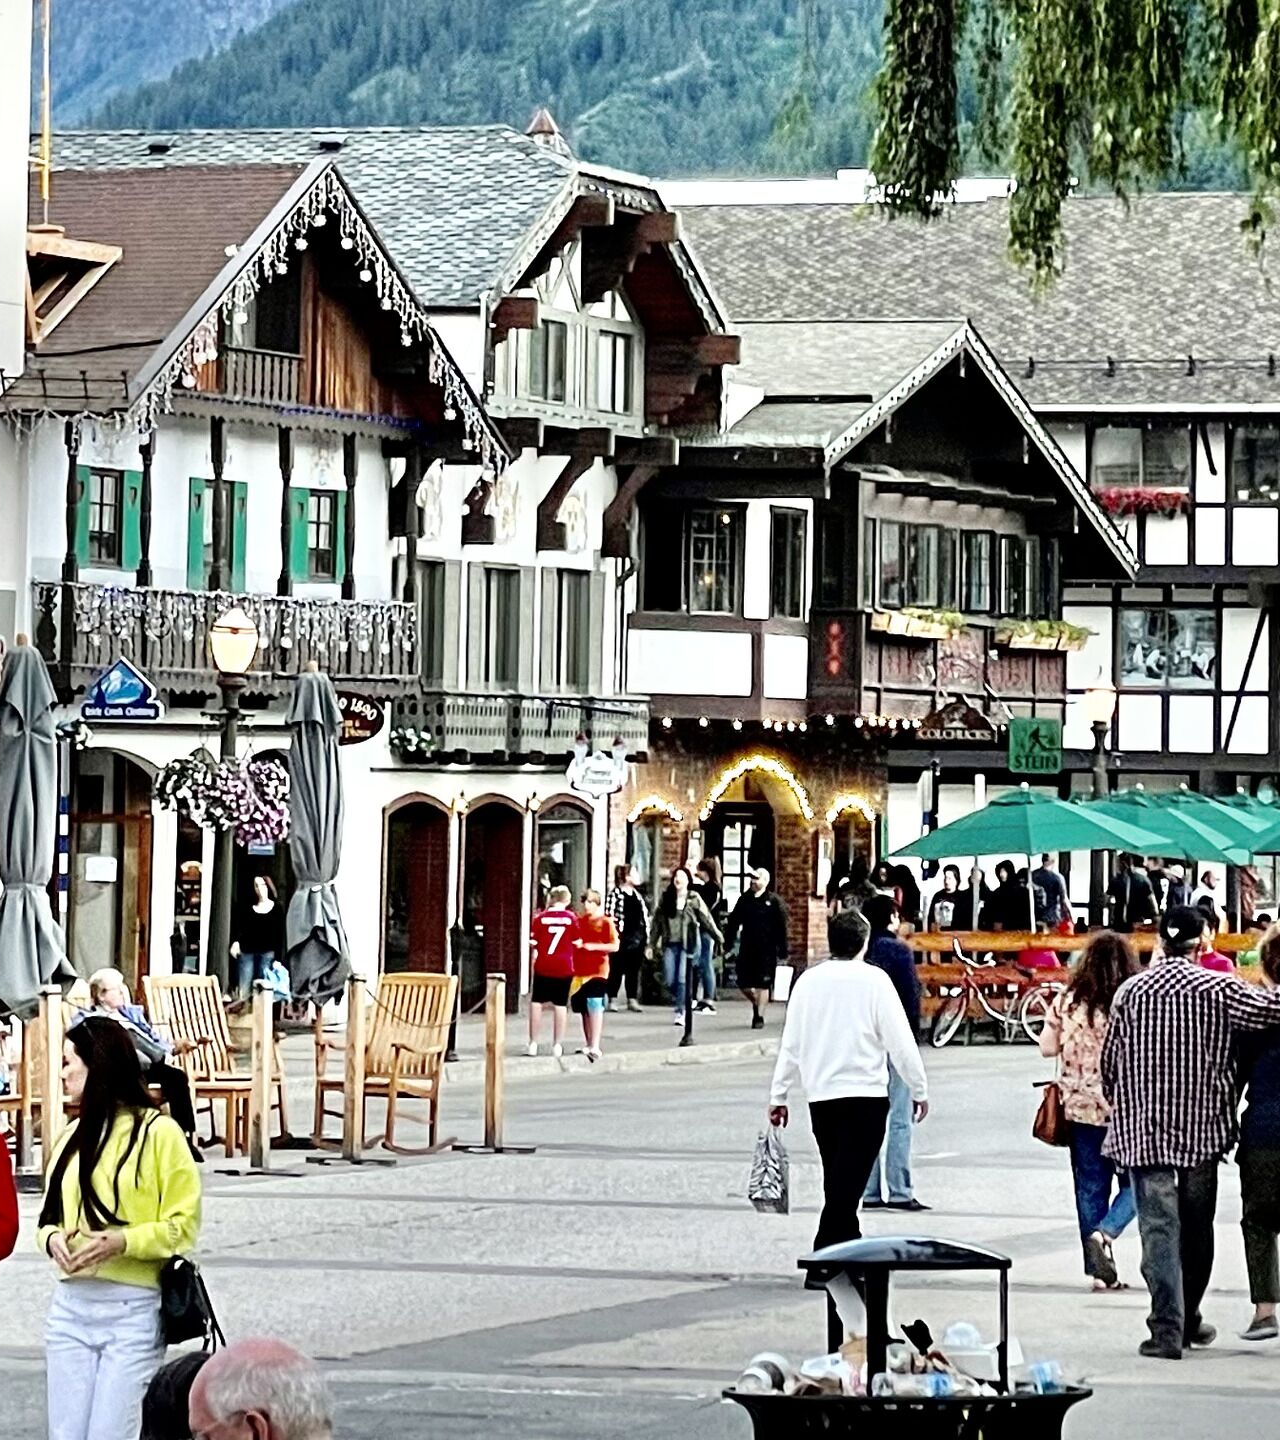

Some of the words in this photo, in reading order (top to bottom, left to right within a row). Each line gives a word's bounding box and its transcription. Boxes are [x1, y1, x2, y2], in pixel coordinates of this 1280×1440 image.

[350, 697, 378, 721] 1890
[1014, 754, 1058, 769] STEIN
[547, 926, 566, 955] 7
